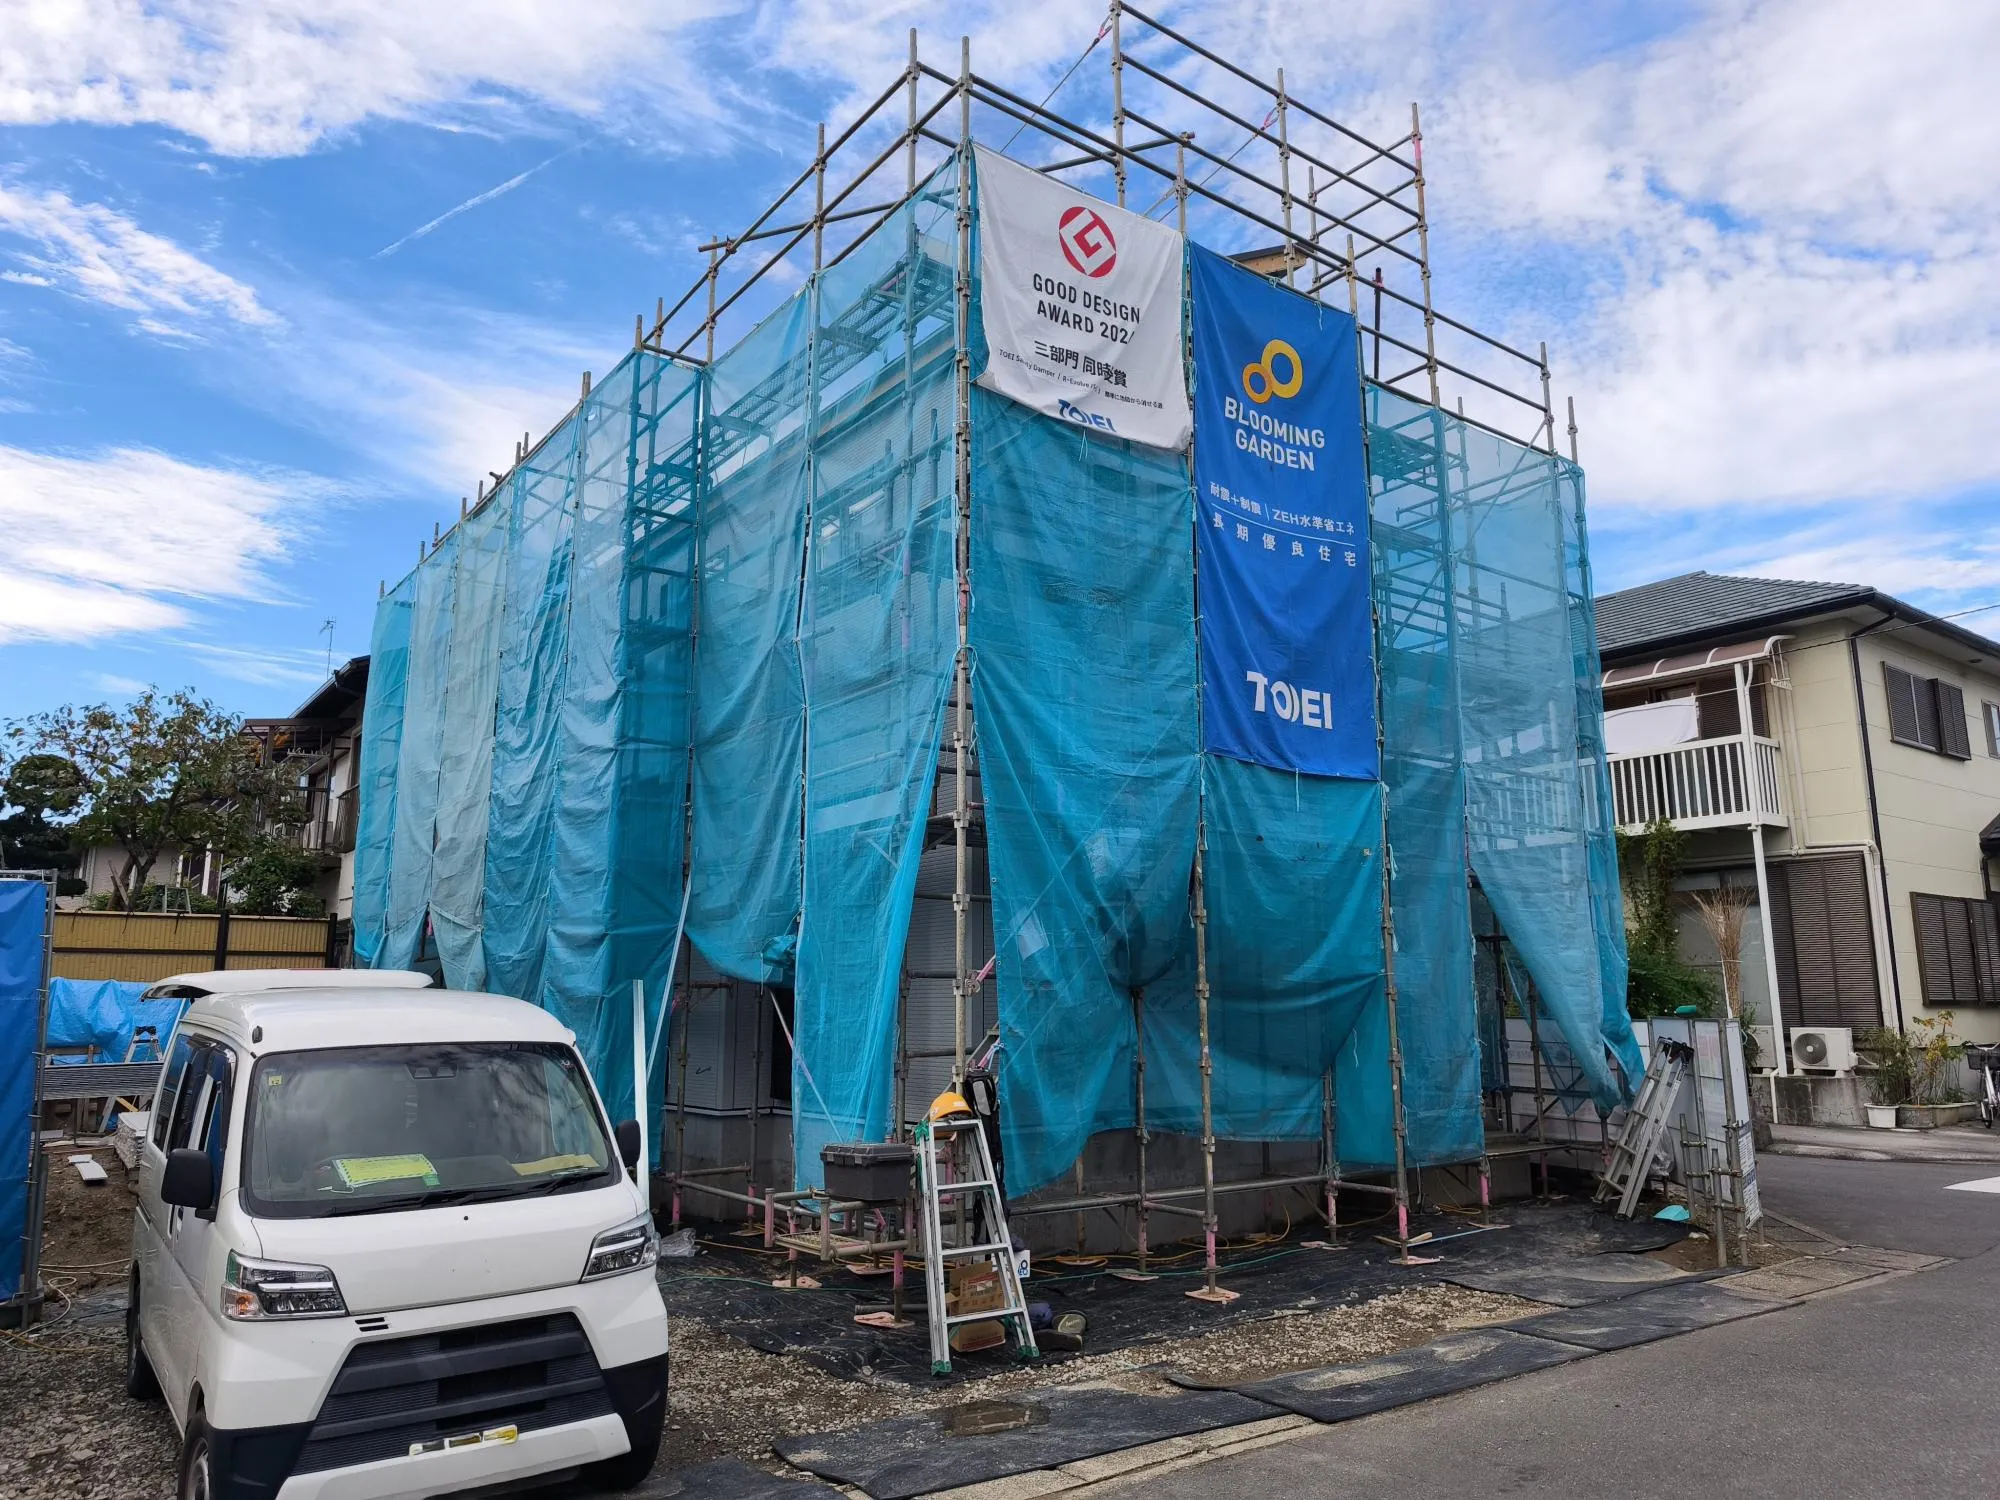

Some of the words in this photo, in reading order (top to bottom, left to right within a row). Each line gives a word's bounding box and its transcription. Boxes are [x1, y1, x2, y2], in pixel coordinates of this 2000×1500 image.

[1033, 273, 1077, 304] GOOD
[1083, 290, 1140, 324] DESIGN
[1037, 300, 1094, 333] AWARD
[999, 348, 1015, 361] TOEI
[1033, 363, 1055, 377] Damper
[1034, 340, 1079, 370] 三部門
[1224, 396, 1325, 449] BLOOMING
[1235, 428, 1315, 472] GARDEN
[1246, 670, 1333, 730] TOEI
